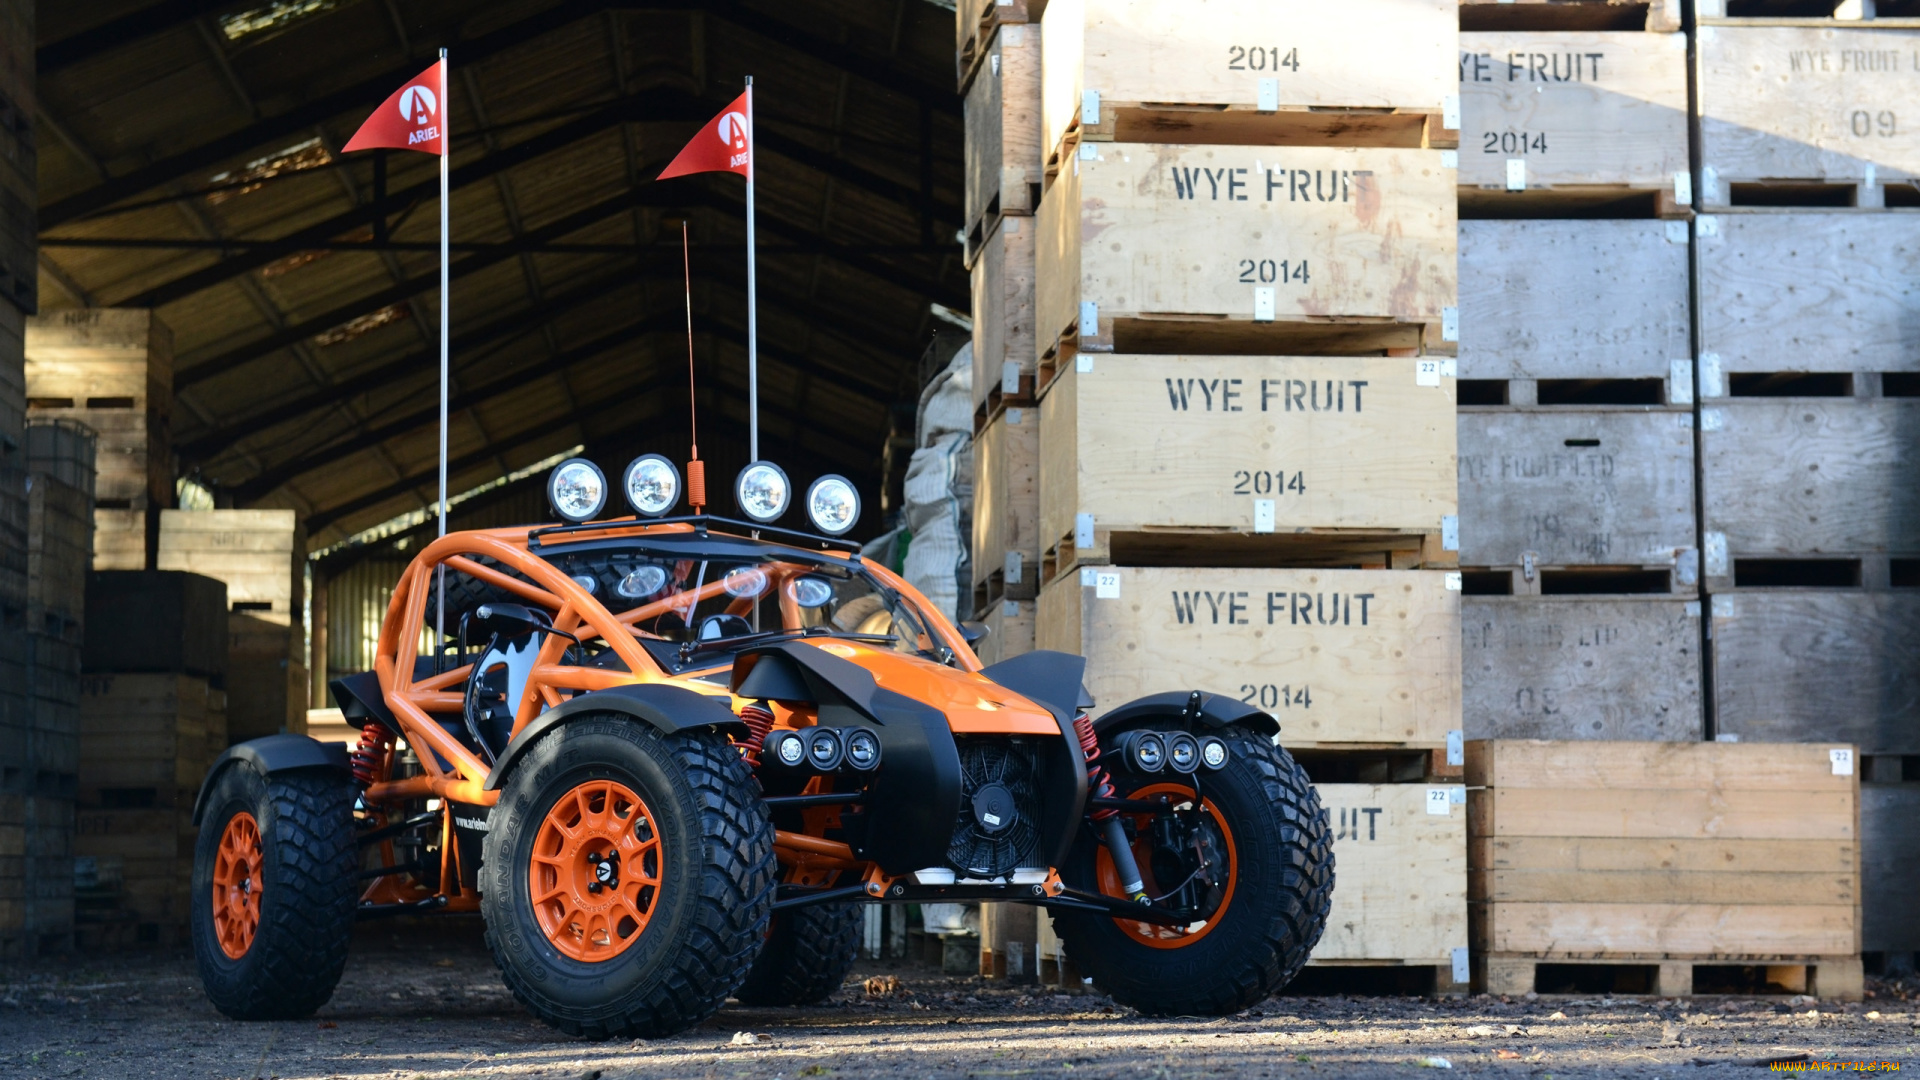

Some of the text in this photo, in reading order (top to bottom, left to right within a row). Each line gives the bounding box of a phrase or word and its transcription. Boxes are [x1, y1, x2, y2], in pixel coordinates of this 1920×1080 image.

[1229, 46, 1299, 72] 2014
[1459, 53, 1604, 82] YE FRUIT
[1788, 50, 1830, 71] WYE
[1840, 50, 1899, 72] FRUIT
[408, 126, 440, 145] ARIEL
[1851, 110, 1896, 138] 09
[1484, 131, 1548, 154] 2014
[730, 151, 748, 168] ARIE
[1172, 167, 1374, 203] WYE FRUIT
[1239, 259, 1310, 284] 2014
[1422, 363, 1435, 372] 22
[1166, 378, 1369, 412] WYE FRUIT
[1458, 455, 1490, 478] YE
[1233, 470, 1306, 496] 2014
[1102, 576, 1115, 585] 22
[1172, 591, 1375, 625] WYE FRUIT
[1240, 684, 1312, 709] 2014
[1835, 751, 1848, 760] 22
[1432, 791, 1445, 800] 22
[455, 816, 488, 831] www.arielm
[1325, 807, 1383, 841] UIT
[497, 791, 549, 983] GEOLANDAR
[634, 793, 681, 971] YOKOHAMA
